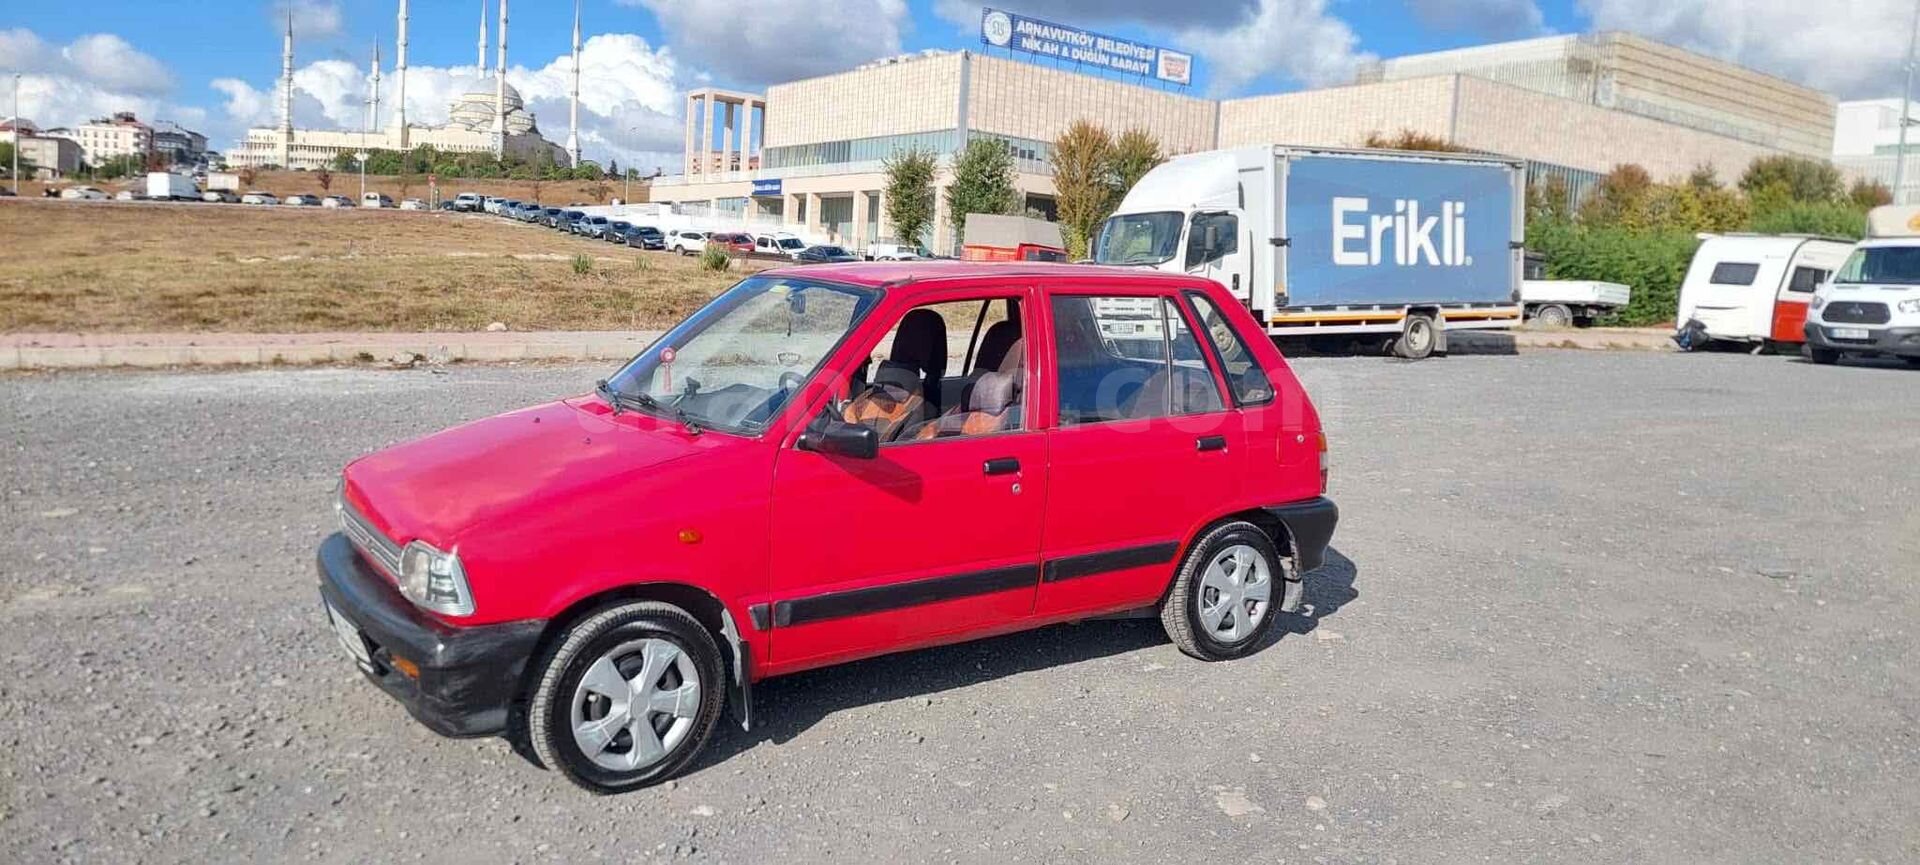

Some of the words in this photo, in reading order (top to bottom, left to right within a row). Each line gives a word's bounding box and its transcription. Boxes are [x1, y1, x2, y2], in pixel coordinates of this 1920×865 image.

[1016, 20, 1095, 47] ARNAVUTKÖY
[1097, 37, 1156, 61] BELEDİYESİ
[1022, 35, 1059, 55] NİKAH
[1062, 46, 1069, 57] &
[1071, 48, 1110, 66] DÜĞÜN
[1111, 56, 1150, 74] SARAYI
[1332, 196, 1465, 266] Erikli
